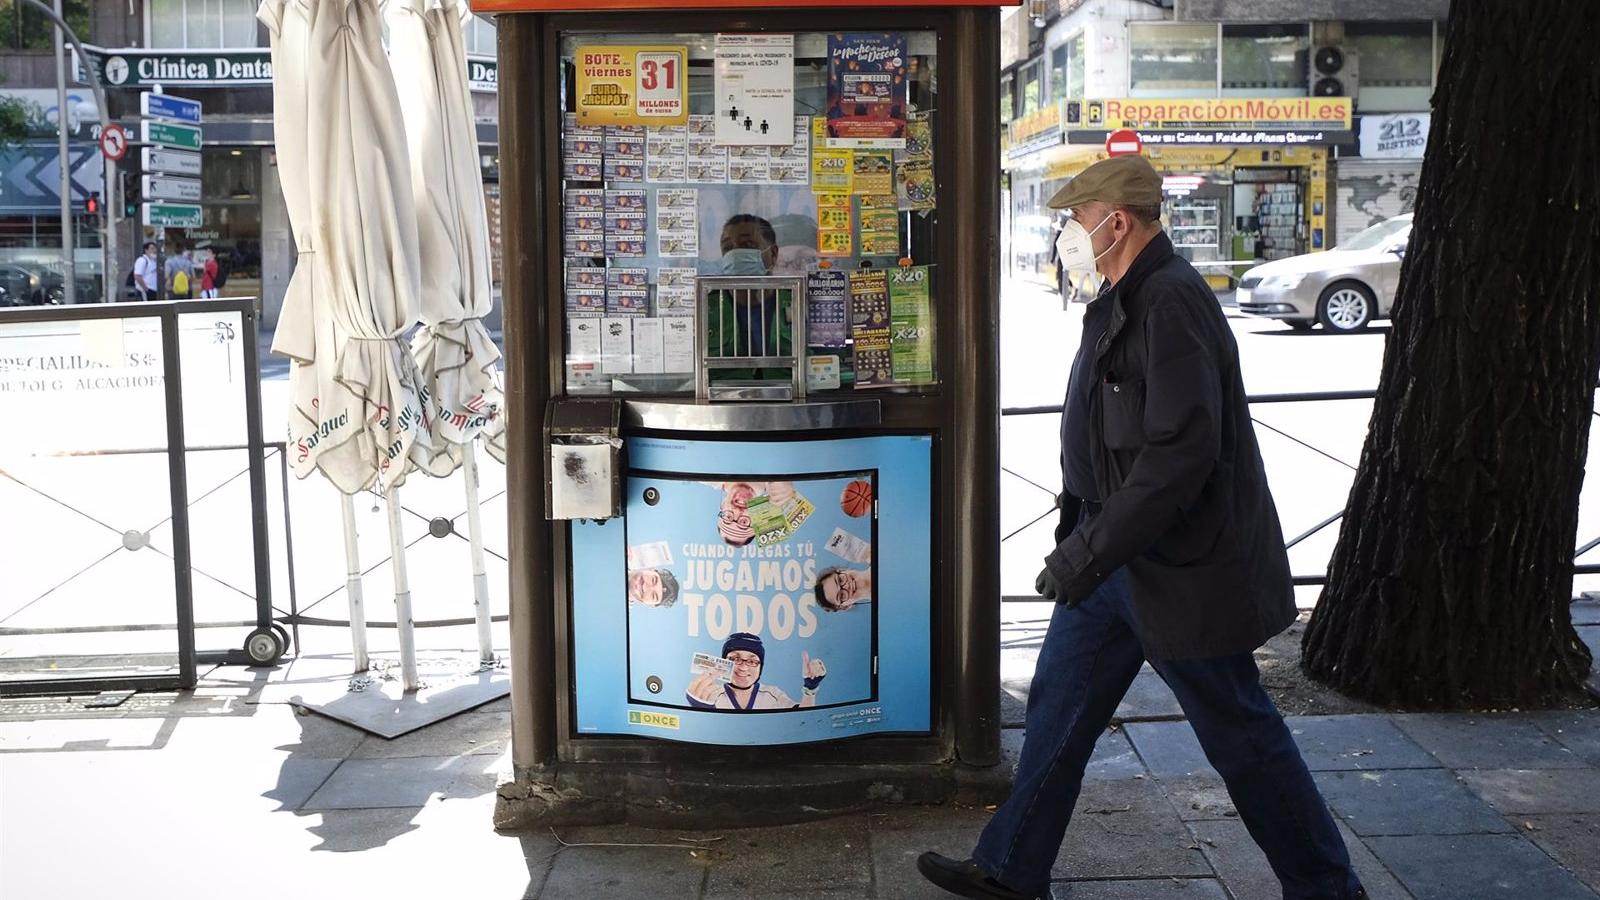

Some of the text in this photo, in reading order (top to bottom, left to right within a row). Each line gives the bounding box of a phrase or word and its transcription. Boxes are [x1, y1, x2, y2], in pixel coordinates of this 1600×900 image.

[584, 54, 620, 65] BOTE
[138, 57, 208, 79] Clínica
[584, 66, 632, 77] viernes
[641, 59, 675, 90] 31
[591, 83, 618, 95] EURO
[582, 94, 628, 106] JACKPOT
[640, 100, 679, 108] MILLONES
[1107, 100, 1346, 124] ReparaciónMóvil.es
[1379, 118, 1421, 140] 212
[1377, 137, 1425, 151] BISTRO
[893, 271, 924, 282] X20
[895, 328, 926, 339] X20
[683, 543, 735, 558] CUANDO
[741, 543, 791, 558] JUEGAS
[682, 558, 818, 592] JUGAMOS
[682, 592, 818, 641] TODOS
[859, 707, 881, 716] ONCE
[643, 714, 677, 727] ONCE
